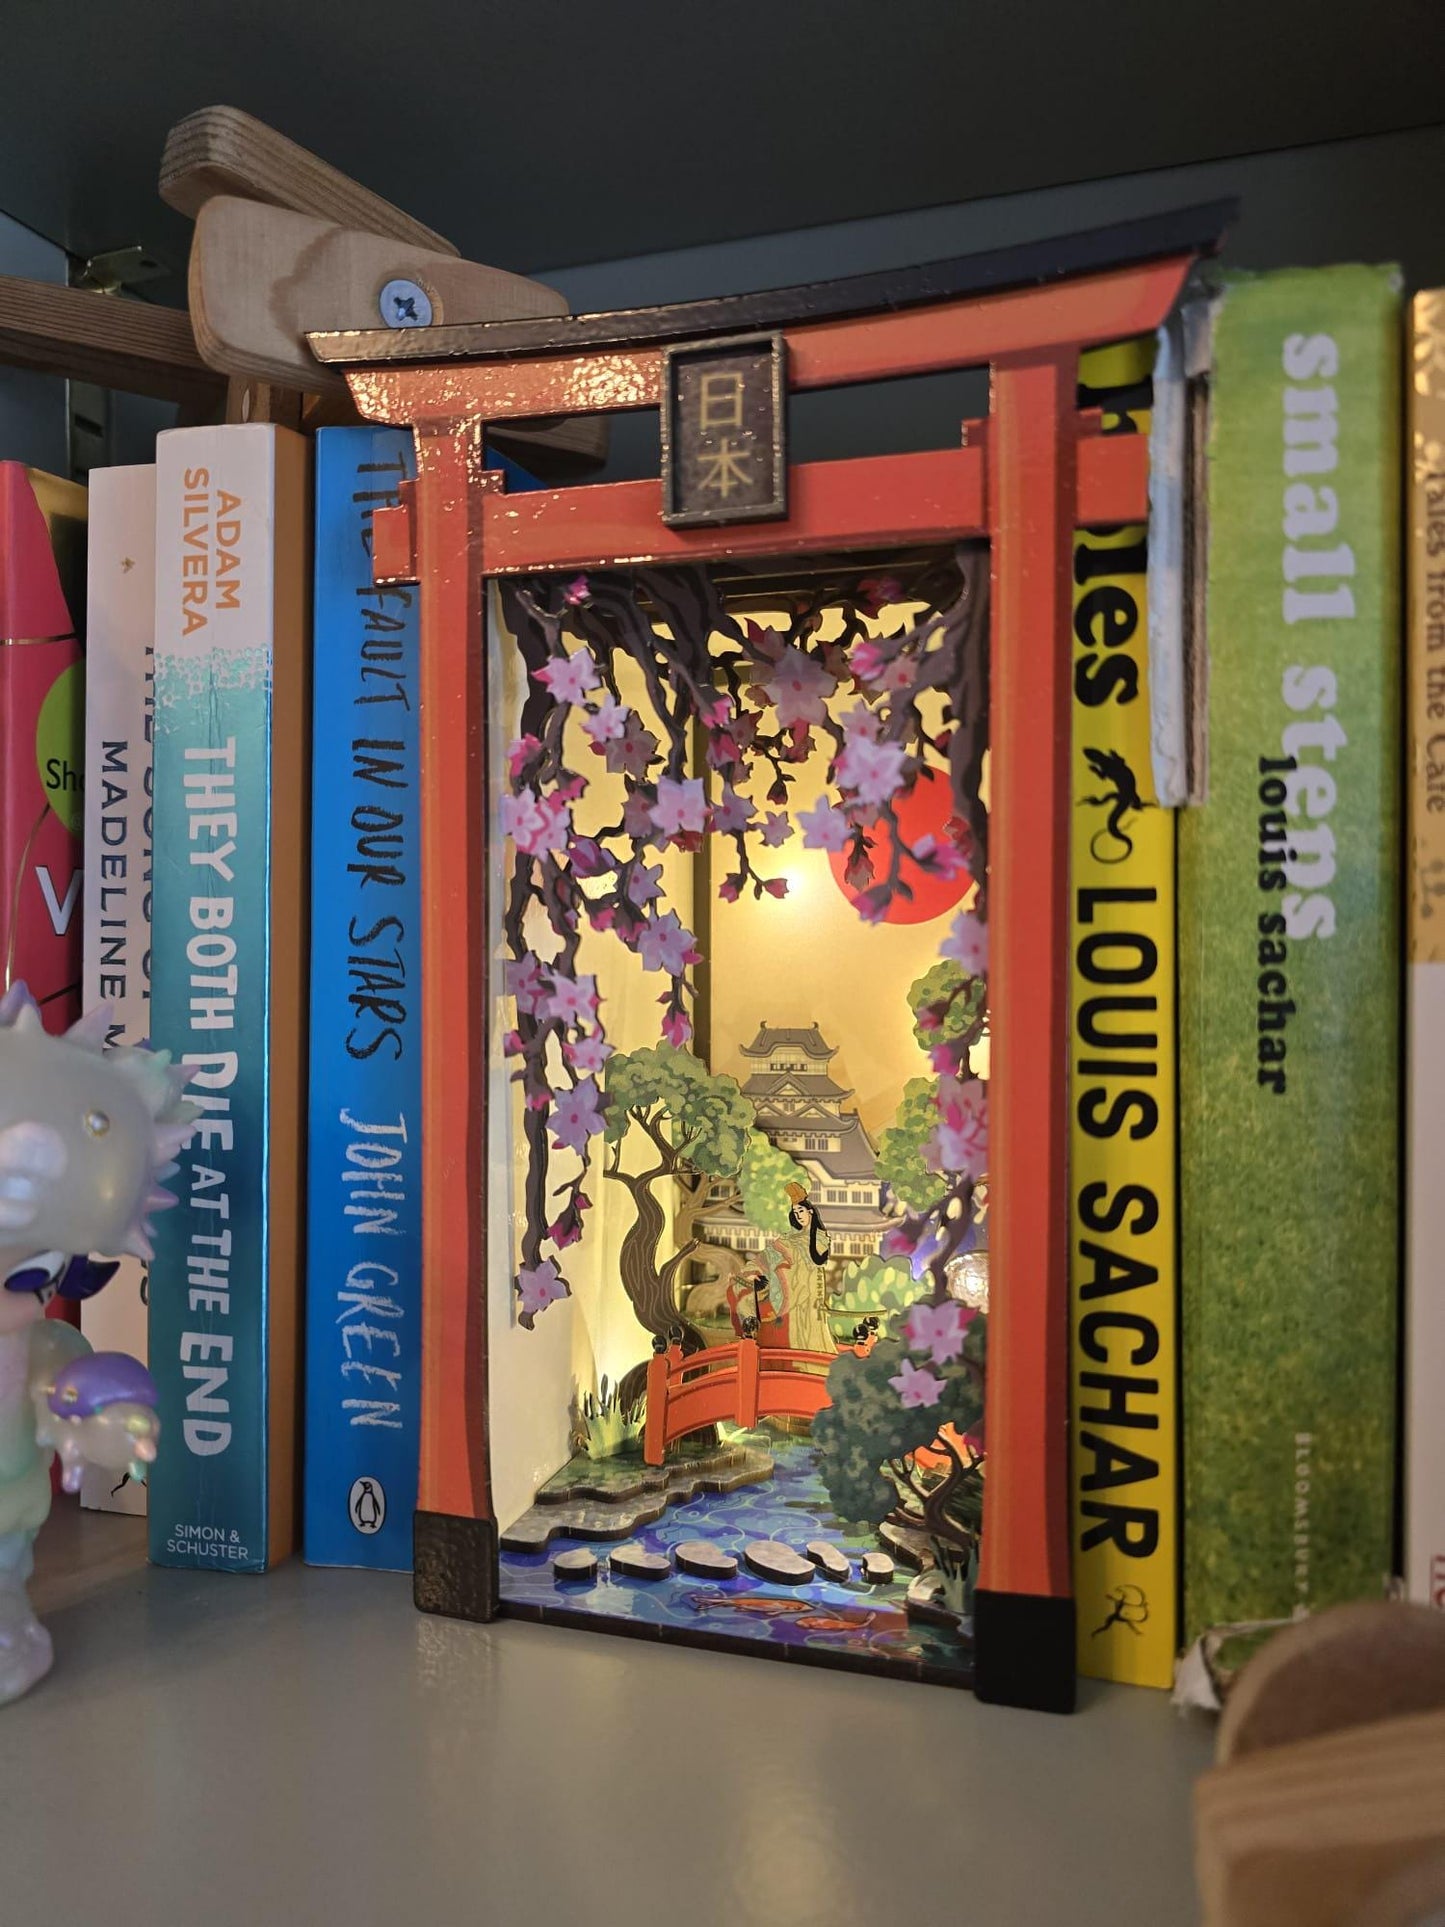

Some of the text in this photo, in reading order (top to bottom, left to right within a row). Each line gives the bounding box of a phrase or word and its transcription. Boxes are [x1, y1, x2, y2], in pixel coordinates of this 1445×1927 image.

[697, 371, 754, 499] 日本
[182, 467, 210, 637] SILVERA
[216, 489, 242, 609] ADAM
[354, 586, 413, 711] FAULT
[1264, 333, 1356, 941] small steps
[352, 739, 408, 788] IN
[100, 740, 128, 999] MADELINE
[347, 805, 406, 889] OUR
[346, 915, 407, 1061] STARS
[1257, 754, 1298, 1095] louis sachar
[180, 736, 238, 1456] THEY BOTH DIE AT THE END
[336, 1108, 408, 1428] JOHN GREEN
[1076, 887, 1160, 1560] LOUIS SACHAR
[166, 1539, 249, 1561] SCHUSTER
[175, 1523, 241, 1543] SIMON &
